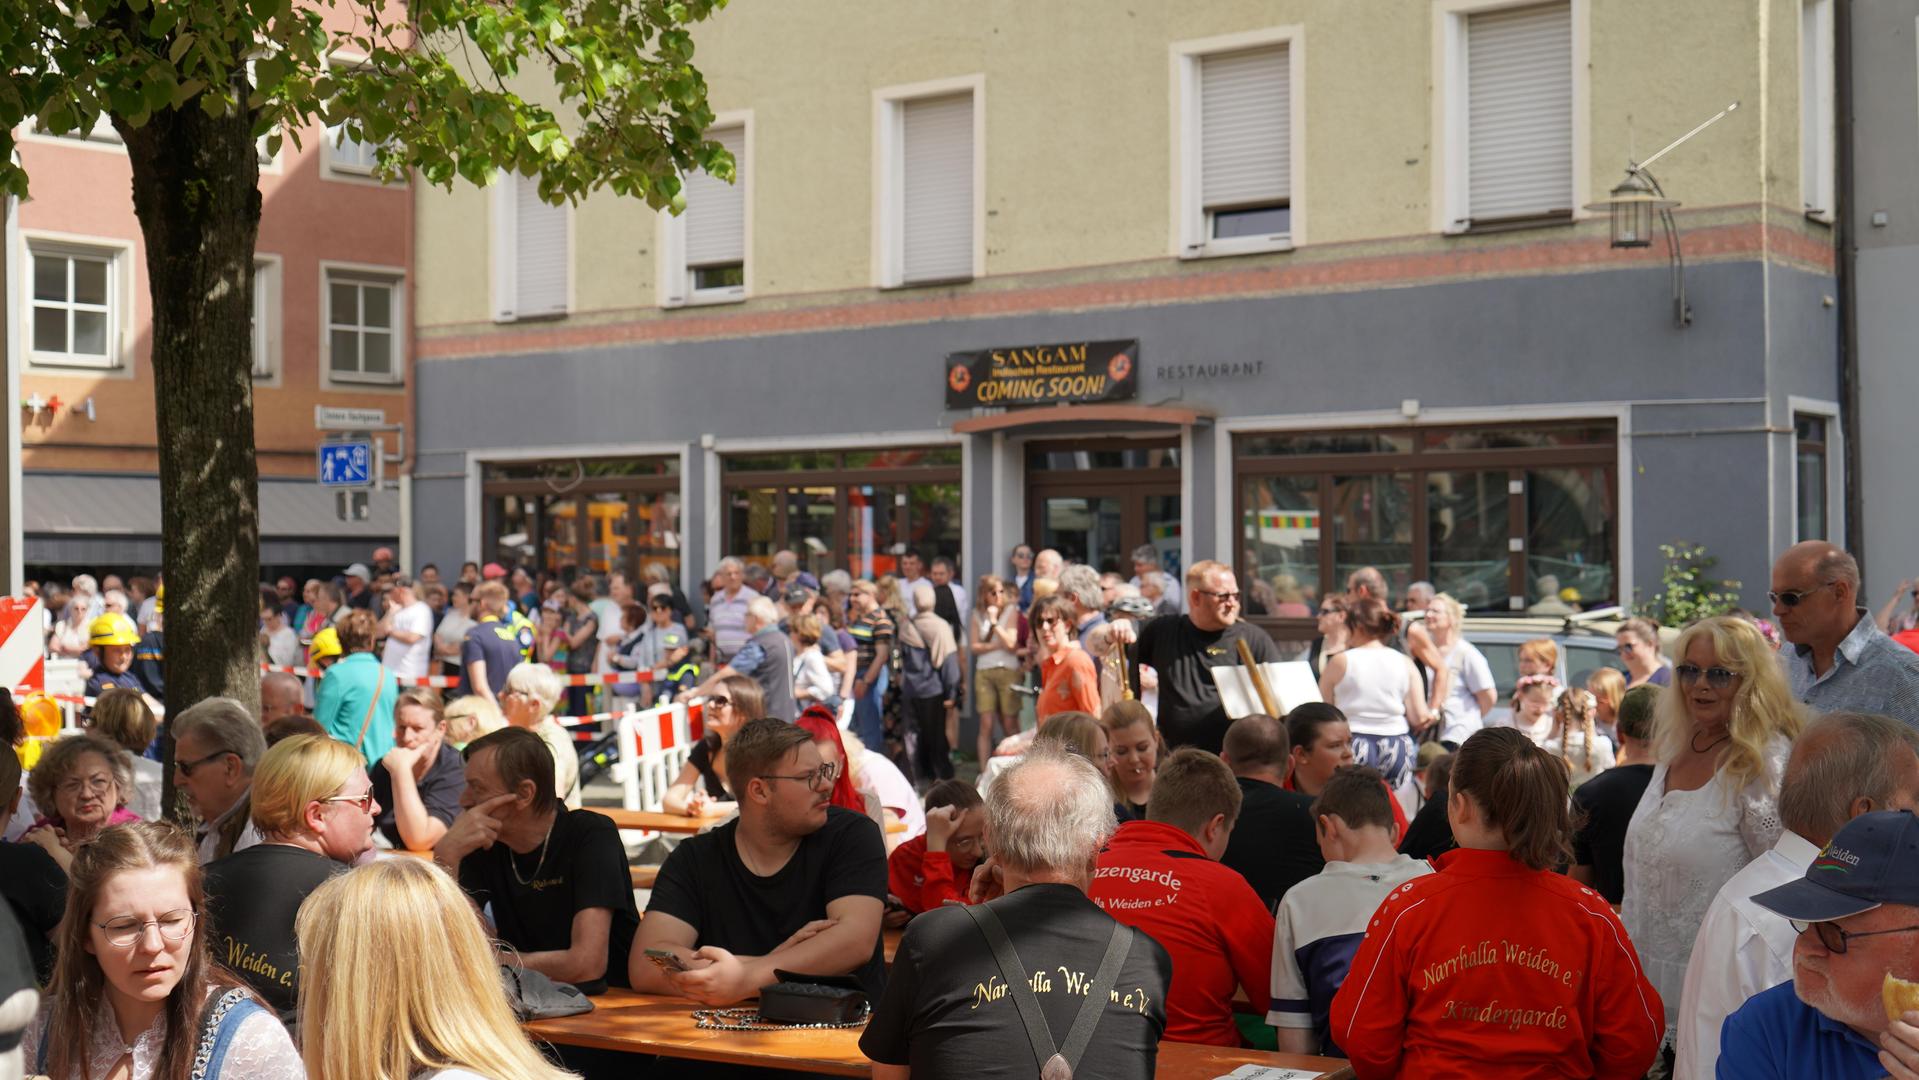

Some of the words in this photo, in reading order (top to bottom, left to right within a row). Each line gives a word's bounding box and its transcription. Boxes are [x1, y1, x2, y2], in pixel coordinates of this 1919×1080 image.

[992, 345, 1087, 367] SANGAM
[1036, 363, 1085, 375] Restaurant
[1157, 360, 1262, 380] RESTAURANT
[977, 377, 1044, 402] COMING
[1047, 375, 1105, 398] SOON!
[1109, 898, 1152, 910] Weiden
[224, 936, 277, 979] Weiden
[1422, 940, 1498, 991] Narrhalla
[1501, 940, 1560, 979] Weiden
[1442, 1000, 1567, 1030] Kindergarde
